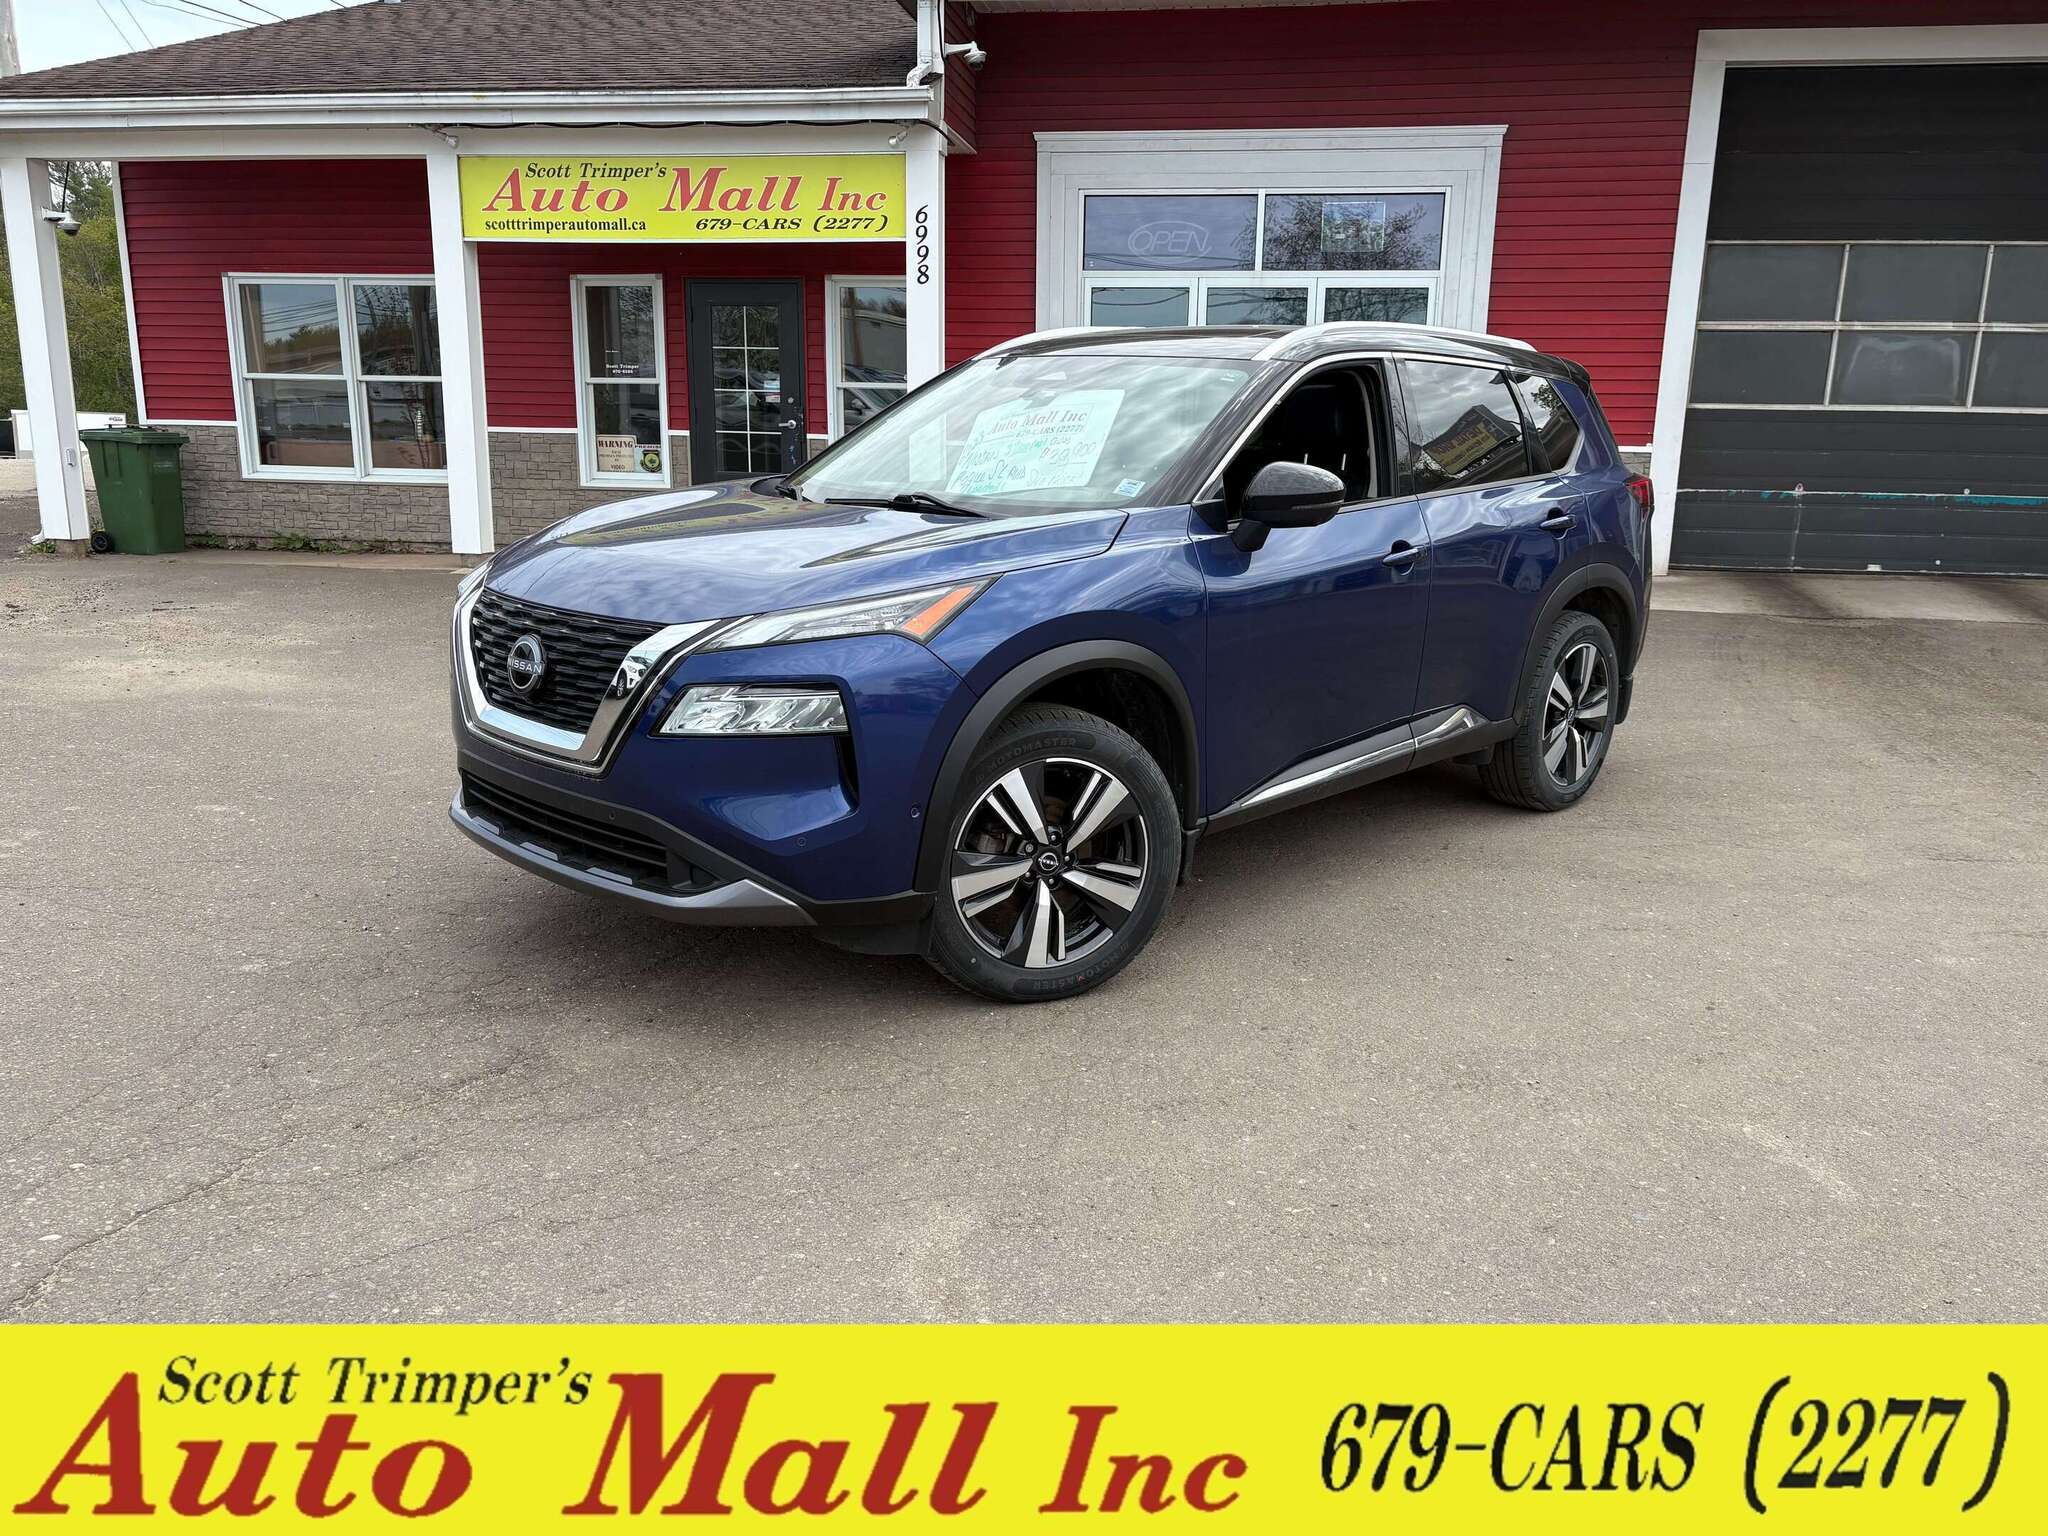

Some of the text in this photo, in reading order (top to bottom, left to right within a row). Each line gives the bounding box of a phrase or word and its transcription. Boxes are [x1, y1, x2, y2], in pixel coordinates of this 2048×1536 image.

[525, 162, 667, 181] Scott Trimper's
[482, 167, 887, 212] Auto Mall Inc
[485, 217, 646, 234] scotttrimperautomall.ca
[695, 214, 888, 232] 679-CARS (2277)
[915, 204, 930, 285] 6998
[1133, 230, 1209, 252] OPEN
[1023, 411, 1058, 427] Mall
[1059, 410, 1088, 423] Inc
[598, 440, 633, 448] WARNING
[511, 658, 542, 673] ISSAN
